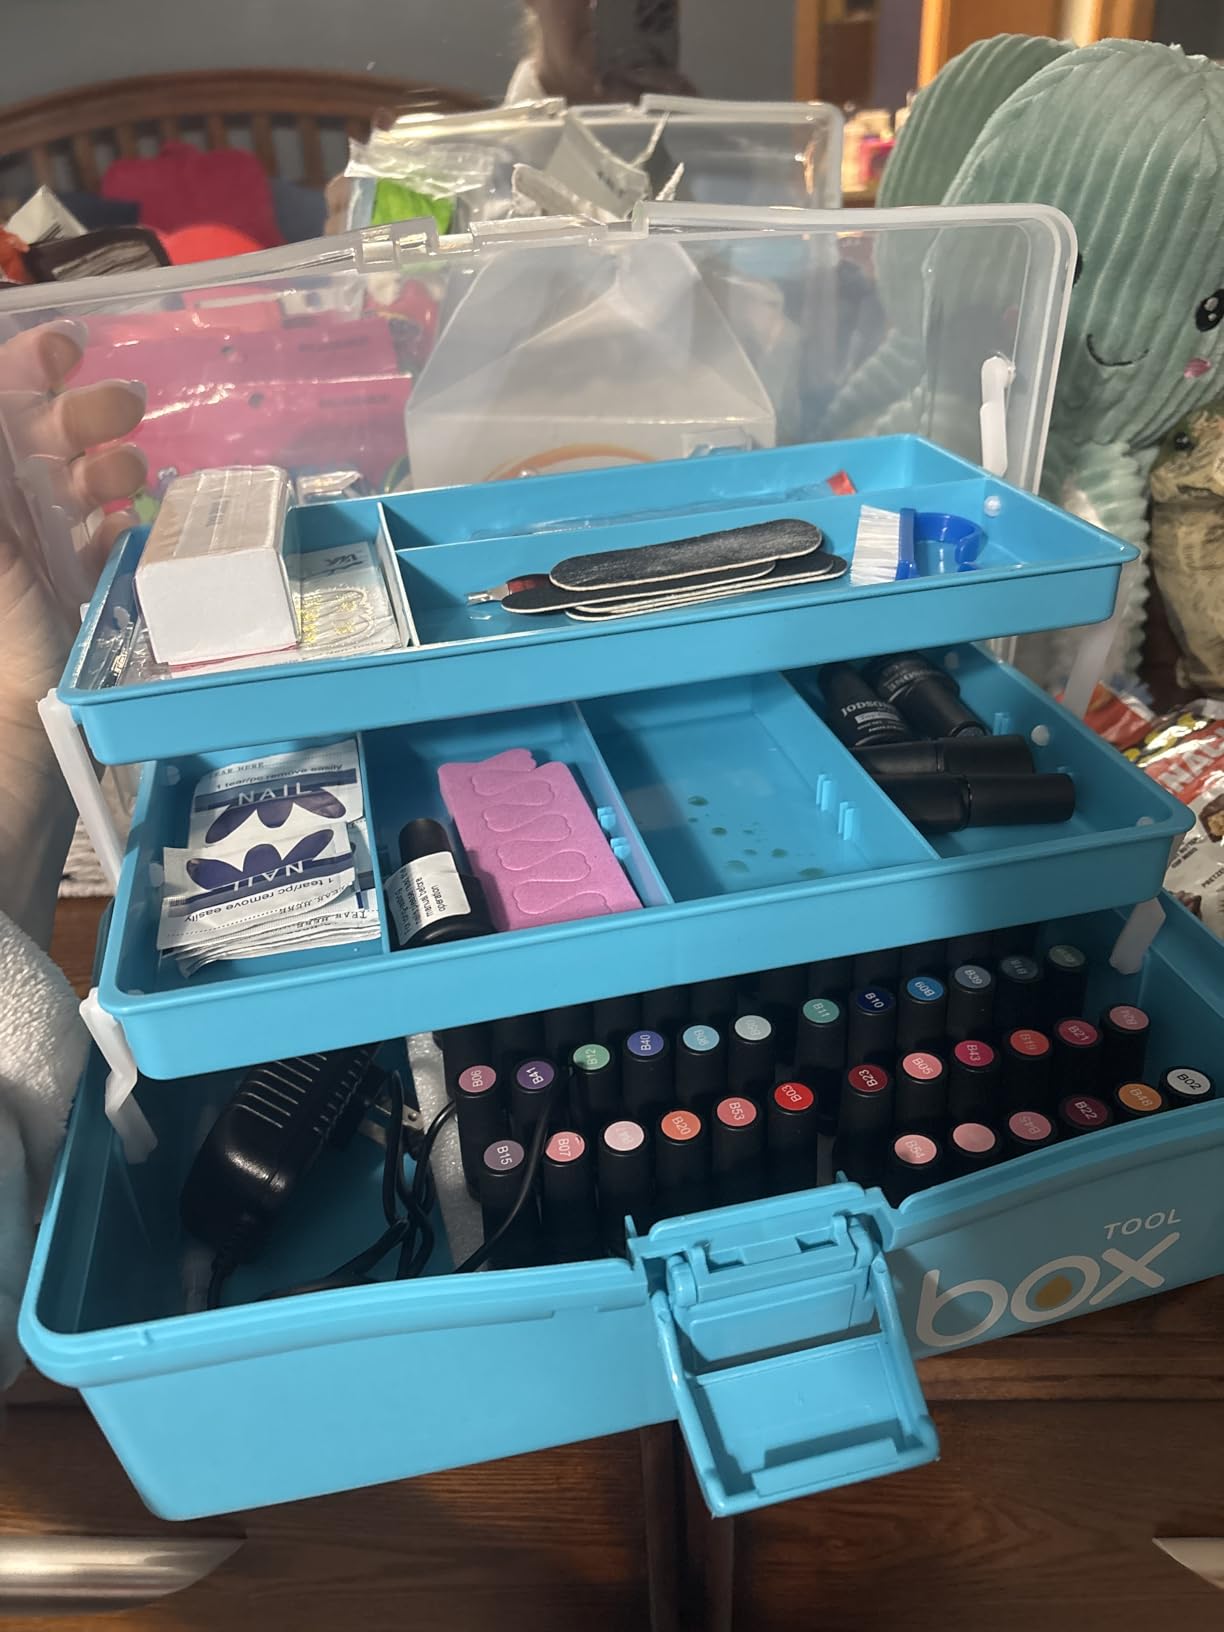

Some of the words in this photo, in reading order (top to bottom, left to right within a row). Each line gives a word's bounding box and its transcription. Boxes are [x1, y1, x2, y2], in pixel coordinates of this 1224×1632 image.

[265, 769, 305, 780] remove
[310, 763, 343, 773] easily
[238, 782, 313, 806] NAIL
[230, 861, 304, 891] NAIL
[278, 879, 323, 892] tear/pc
[415, 877, 427, 897] before
[226, 891, 275, 910] remove
[420, 895, 433, 917] manual
[430, 884, 447, 912] operation
[184, 907, 222, 922] easily
[963, 969, 984, 986] B39
[914, 981, 935, 997] B09
[812, 1002, 832, 1017] B11
[864, 992, 886, 1009] B10
[638, 1034, 652, 1051] B40
[1067, 1024, 1090, 1042] B21
[584, 1047, 598, 1065] B12
[911, 1056, 934, 1075] B05
[470, 1068, 484, 1088] B06
[525, 1065, 545, 1086] B41
[858, 1069, 880, 1088] B23
[1176, 1073, 1202, 1091] B02
[781, 1083, 803, 1103] B03
[727, 1102, 746, 1121] B53
[1074, 1100, 1098, 1120] B22
[671, 1115, 692, 1135] B20
[496, 1144, 514, 1165] B15
[557, 1138, 572, 1158] B07
[1104, 1208, 1182, 1239] TOOL
[916, 1232, 1180, 1347] box
